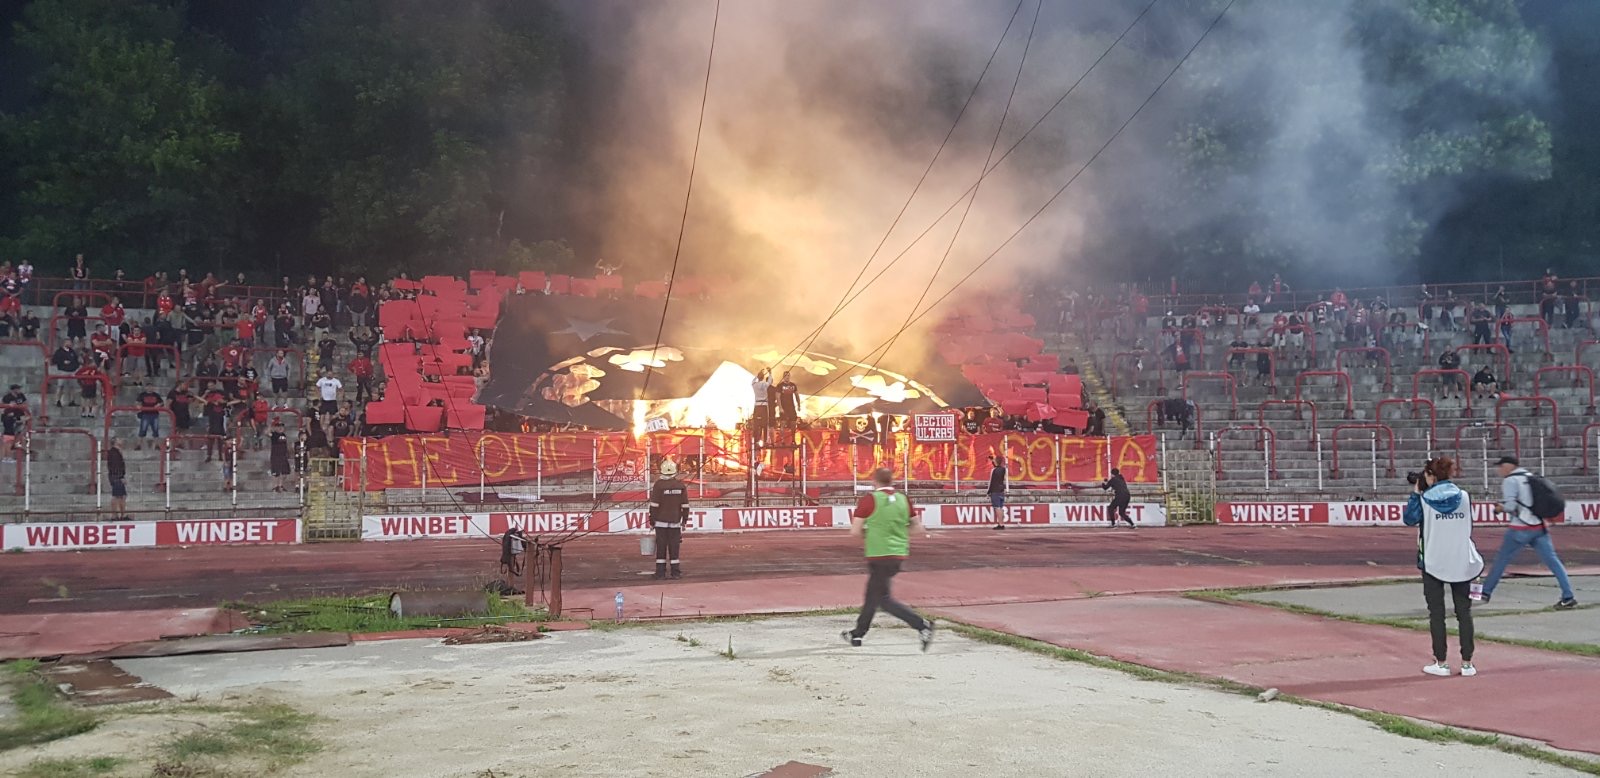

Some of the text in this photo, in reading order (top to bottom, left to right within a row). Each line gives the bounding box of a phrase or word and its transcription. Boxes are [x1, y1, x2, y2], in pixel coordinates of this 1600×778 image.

[916, 416, 954, 427] LEGION
[916, 427, 952, 439] ULTRAS
[343, 437, 457, 485] THE
[999, 433, 1146, 482] SOFIA
[738, 509, 818, 528] WINBET
[1230, 503, 1314, 522] WINBET
[1343, 504, 1408, 521] WINB
[1435, 512, 1465, 521] PHOTO
[176, 521, 278, 542] WINBET
[380, 515, 473, 536] WINBET
[506, 513, 593, 532] WINBET
[26, 524, 136, 546] WINBET
